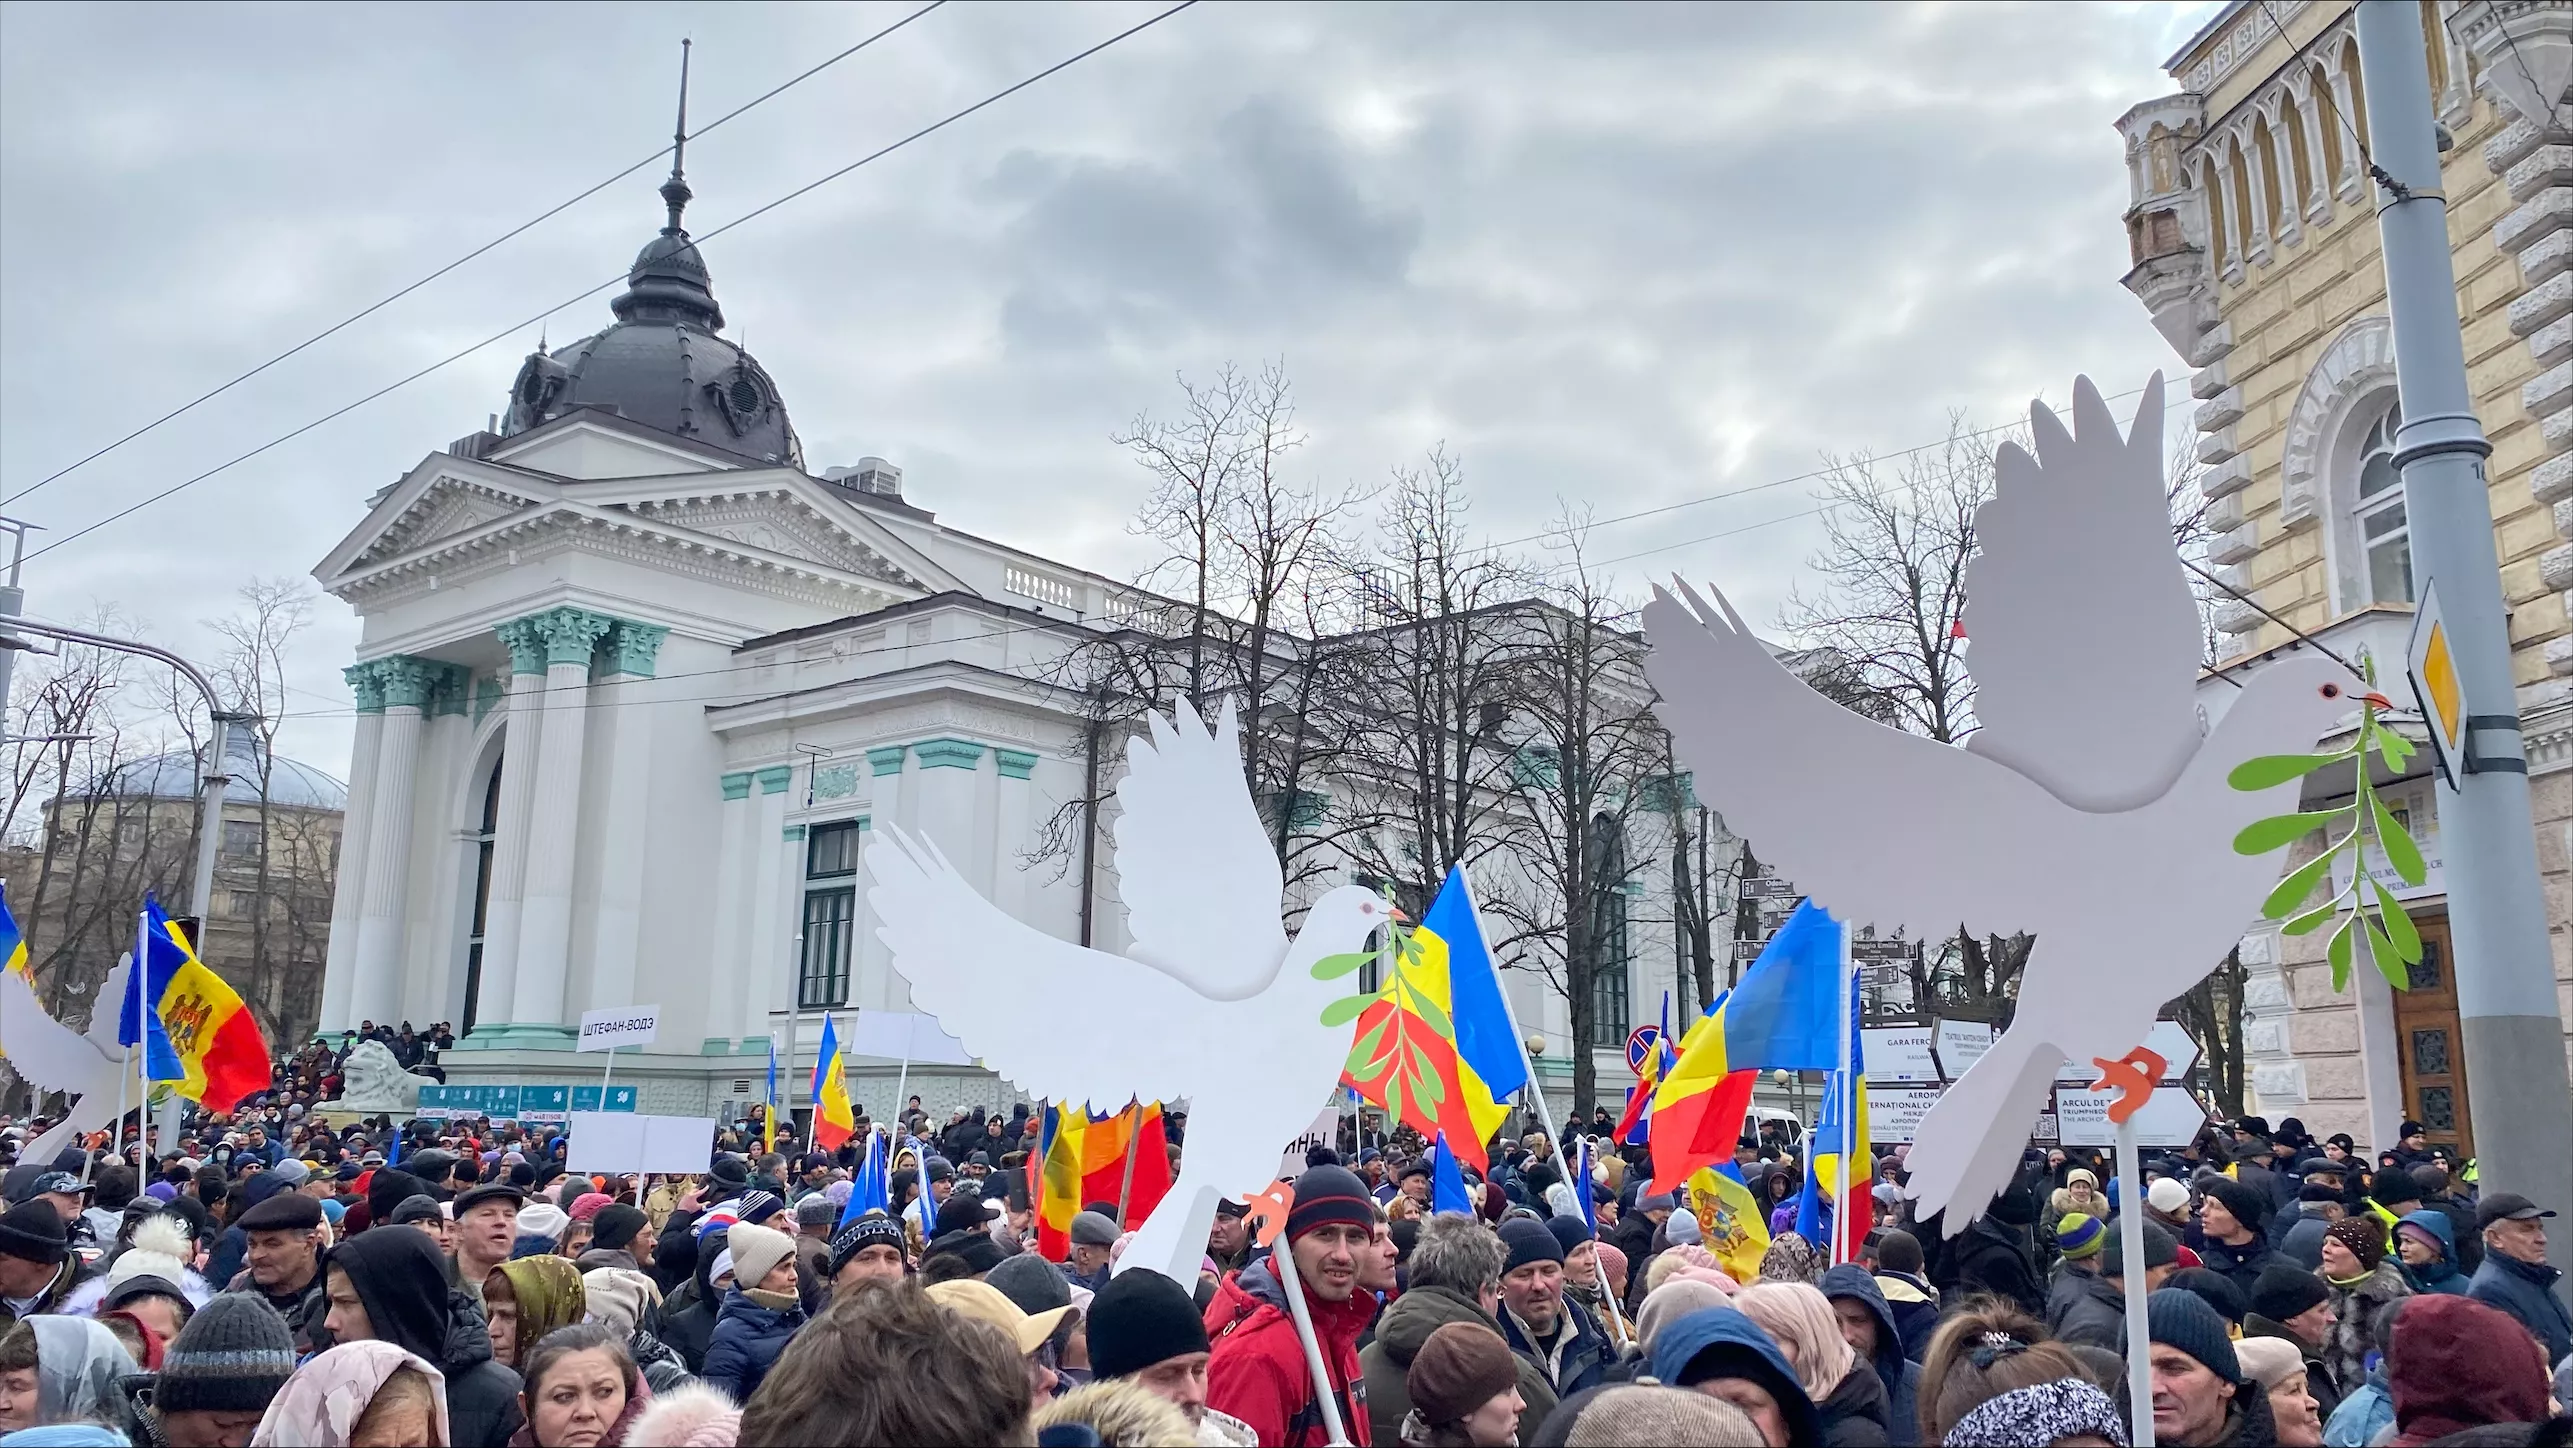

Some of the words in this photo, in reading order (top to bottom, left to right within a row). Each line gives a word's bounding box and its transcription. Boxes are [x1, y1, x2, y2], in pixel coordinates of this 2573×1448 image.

[583, 1017, 654, 1036] ШТЕФАН-ВОДЭ
[1887, 1039, 1910, 1047] GARA
[2063, 1099, 2092, 1107] ARCUL
[2093, 1099, 2105, 1107] DE
